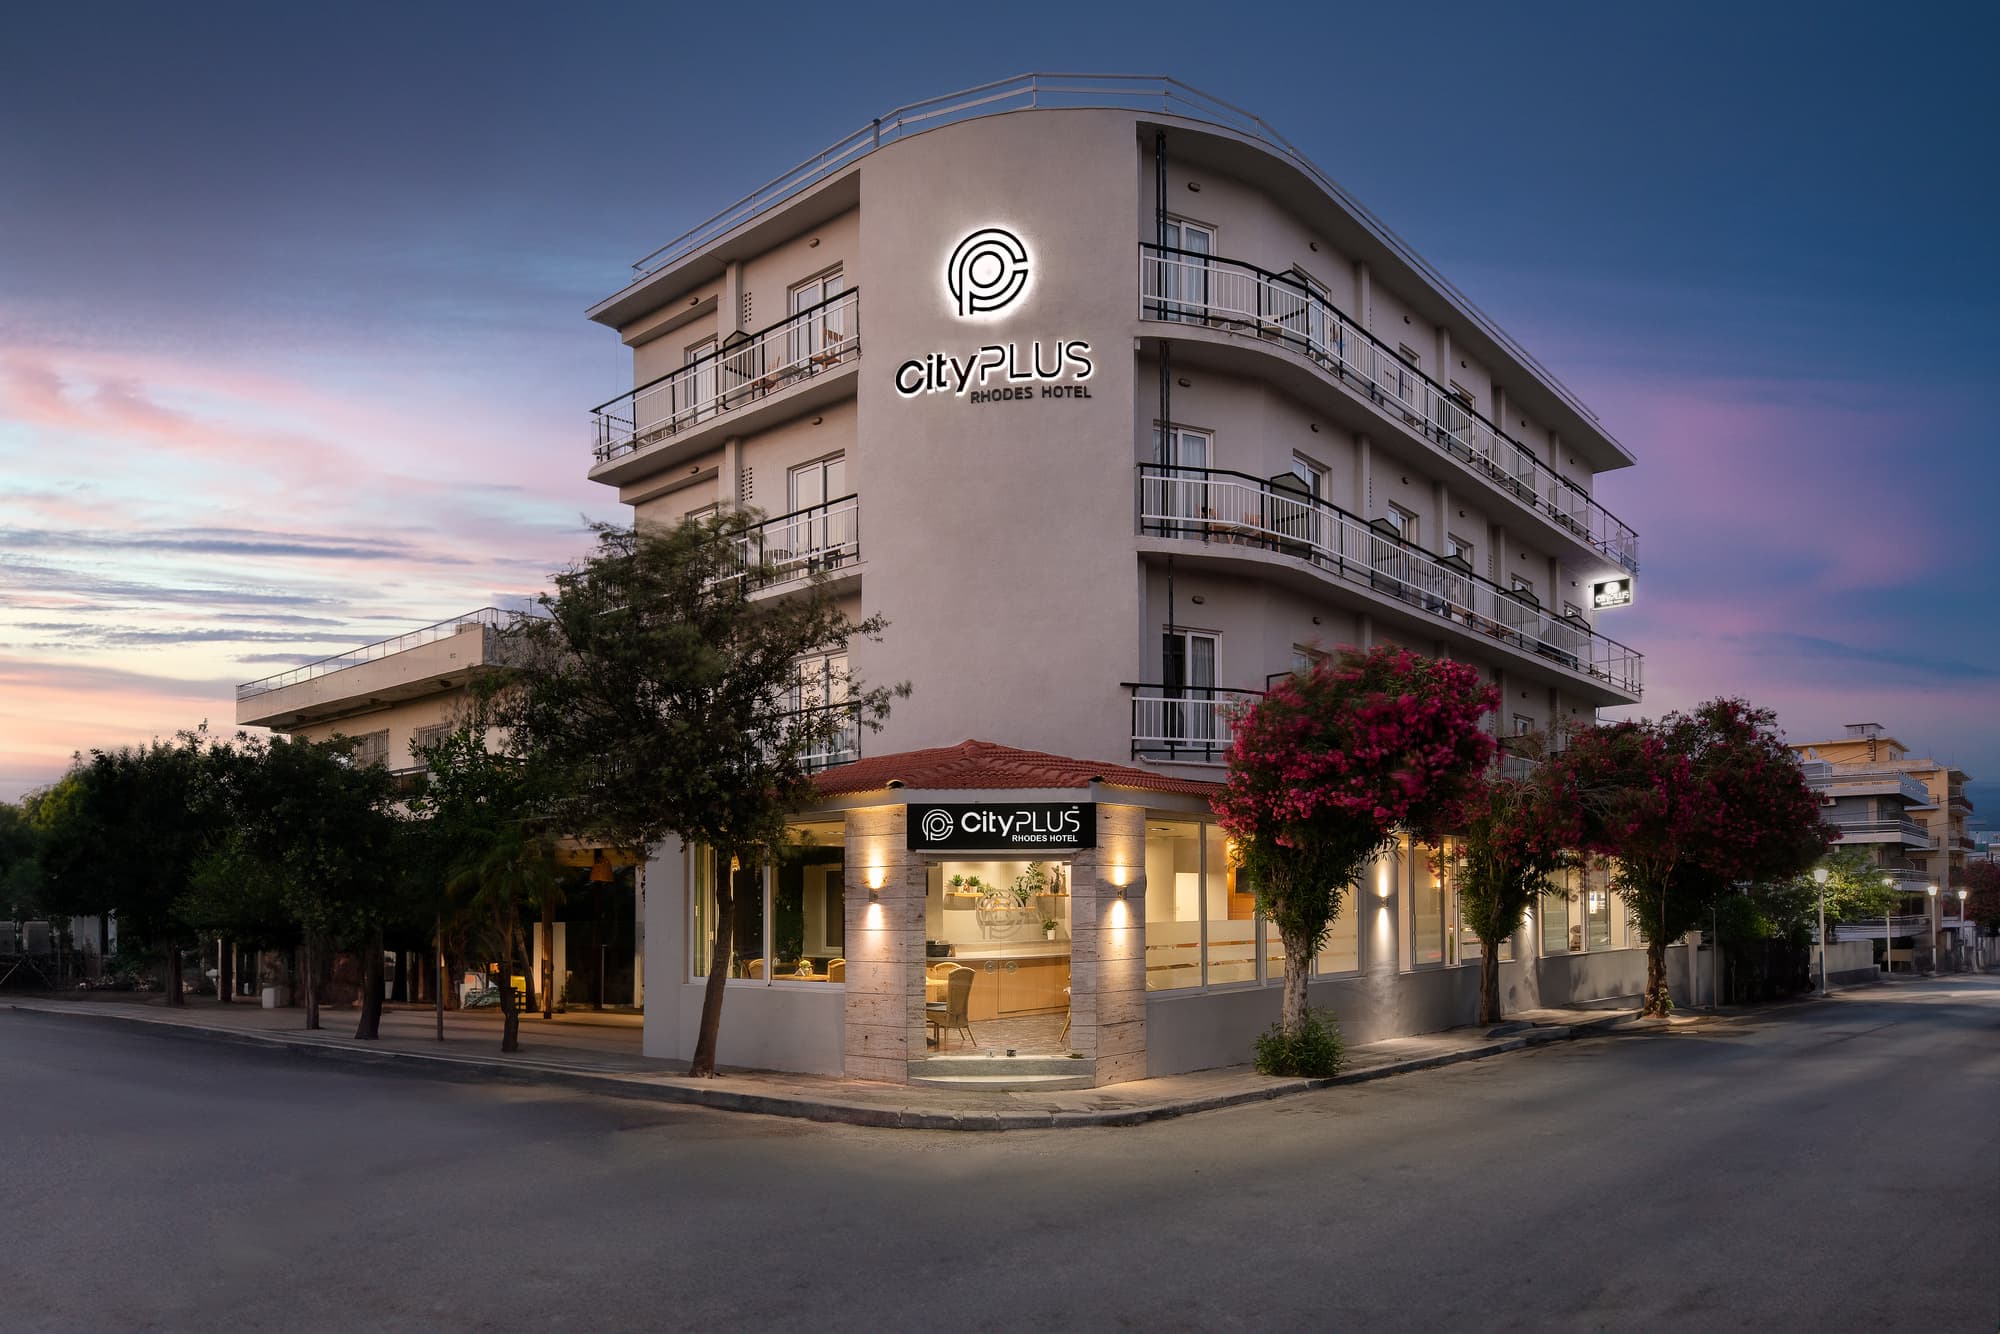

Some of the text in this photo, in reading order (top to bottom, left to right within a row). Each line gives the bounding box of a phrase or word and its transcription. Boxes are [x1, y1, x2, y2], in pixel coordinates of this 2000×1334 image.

[971, 385, 1092, 404] RHODES HOTEL
[1012, 834, 1078, 842] RHODES HOTEL
